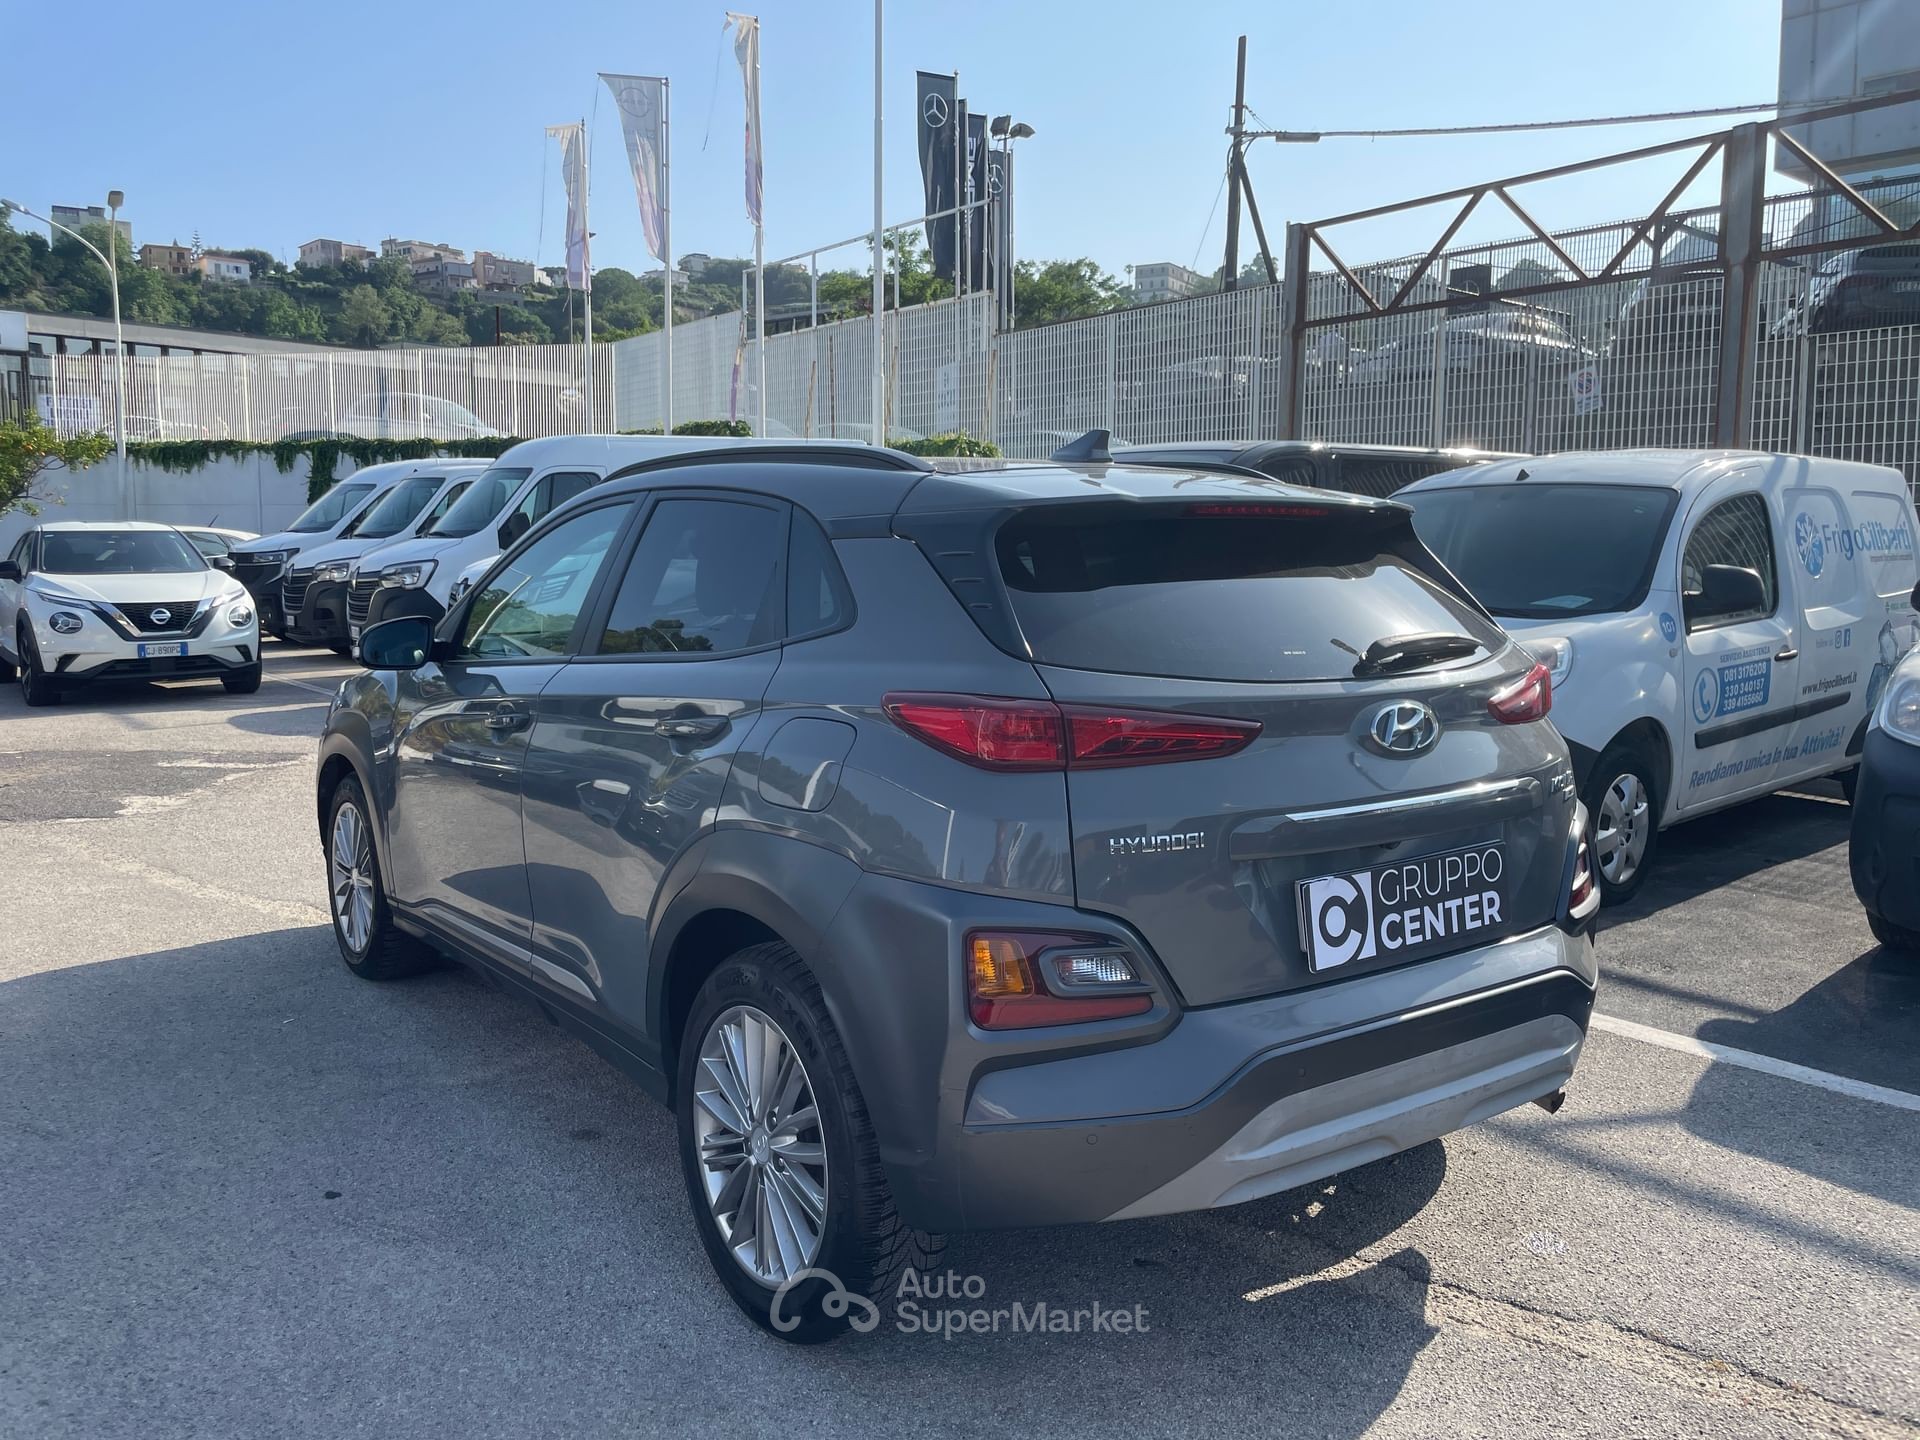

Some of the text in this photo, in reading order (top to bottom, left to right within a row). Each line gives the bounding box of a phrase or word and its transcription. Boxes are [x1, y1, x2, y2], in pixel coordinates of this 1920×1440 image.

[1662, 621, 1676, 633] 101
[1724, 667, 1737, 682] 081
[1724, 684, 1739, 698] 330
[1688, 760, 1744, 790] Rendiamo
[1744, 751, 1772, 772] unica
[1772, 746, 1782, 764] la
[1782, 744, 1799, 761] tua
[1109, 831, 1206, 856] HYUNDAI
[1378, 847, 1503, 906] GRUPPO
[1380, 889, 1503, 950] CENTER
[762, 980, 819, 1058] NEXEN
